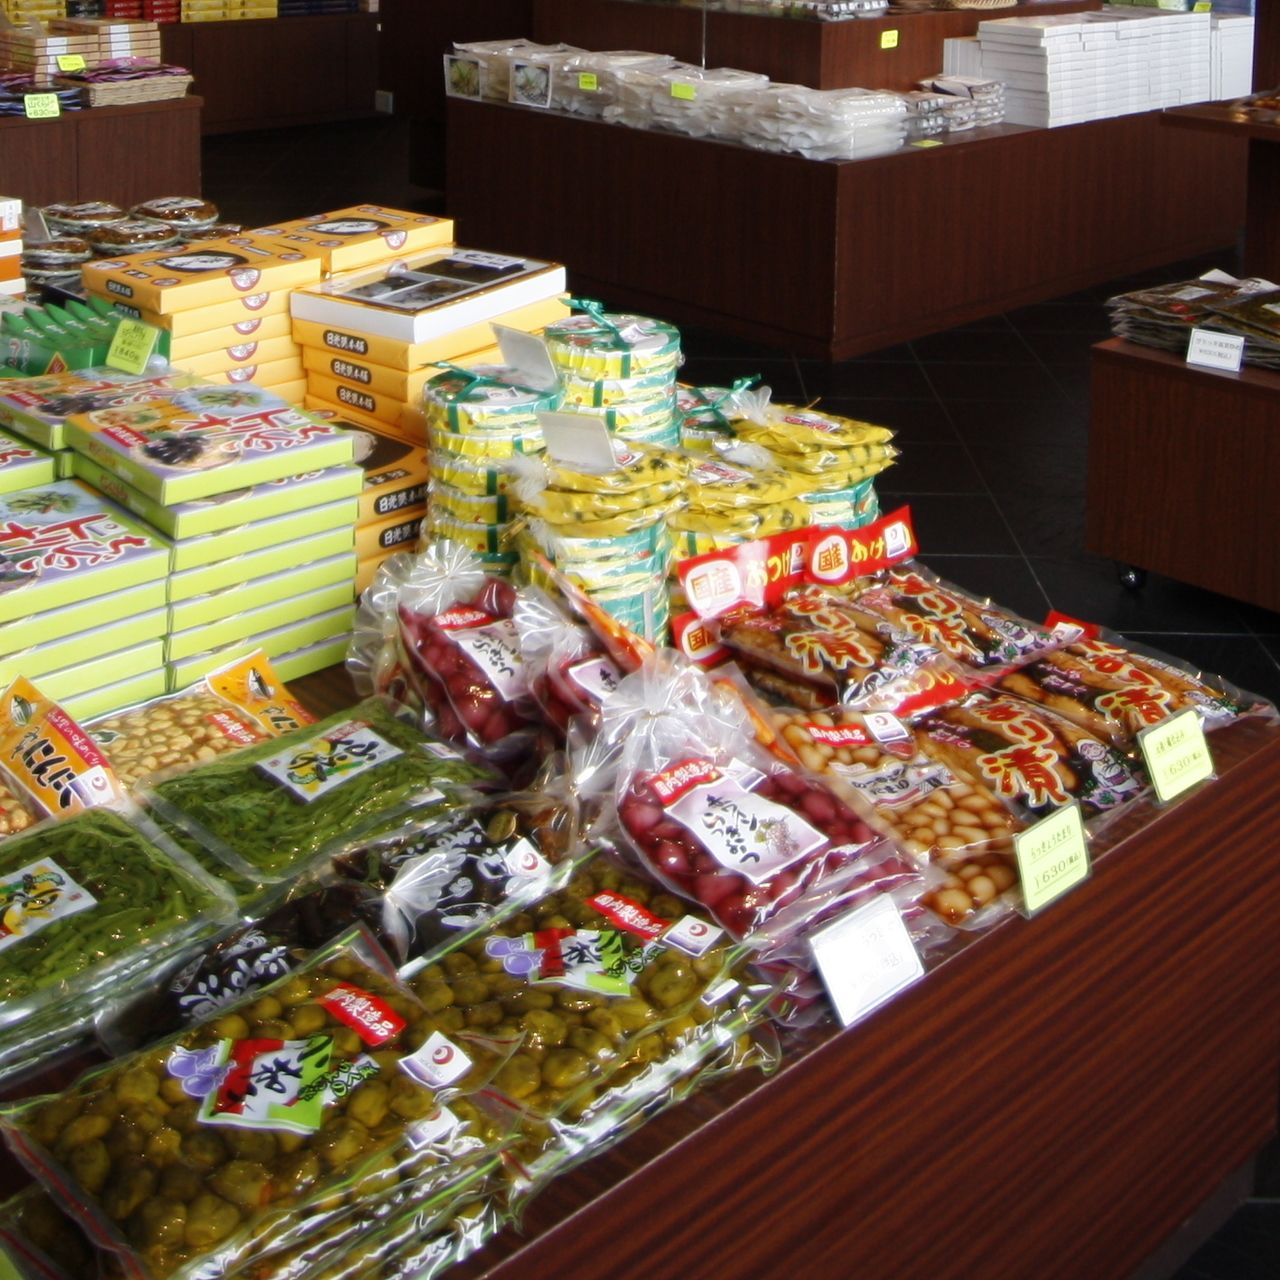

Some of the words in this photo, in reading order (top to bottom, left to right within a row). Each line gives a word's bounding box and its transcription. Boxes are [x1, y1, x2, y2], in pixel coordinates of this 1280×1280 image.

[819, 543, 845, 571] 国産
[653, 762, 715, 796] 国内製造品
[593, 894, 665, 935] 国内製造品
[324, 988, 397, 1038] 国内製造品
